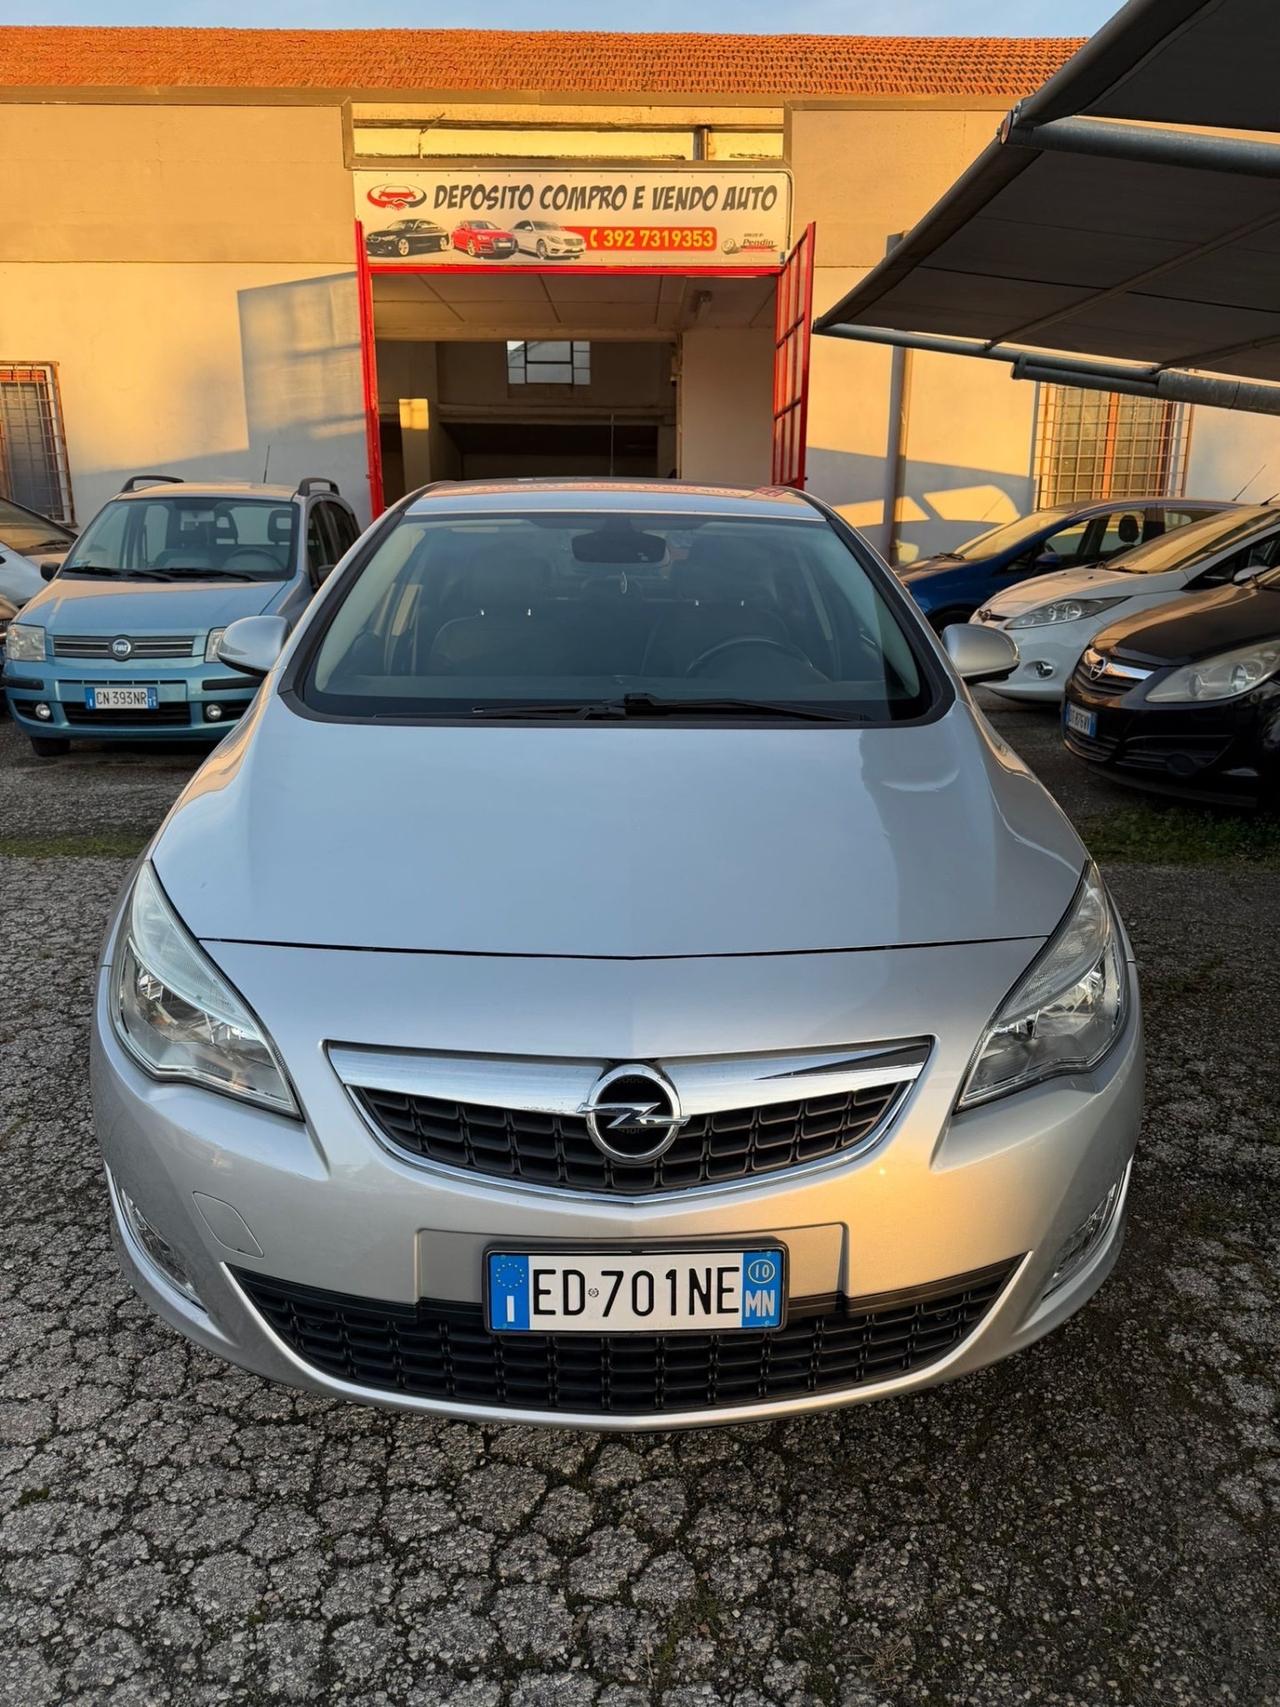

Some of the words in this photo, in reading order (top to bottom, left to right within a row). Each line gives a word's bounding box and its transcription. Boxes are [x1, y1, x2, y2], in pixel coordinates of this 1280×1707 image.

[434, 183, 534, 211] DEPOSITO
[540, 184, 627, 211] COMPRO
[632, 185, 646, 210] E
[652, 184, 718, 212] VENDO
[721, 184, 778, 212] AUTO
[603, 229, 635, 248] 392
[640, 229, 714, 248] 7319353
[96, 692, 110, 704] CN
[113, 691, 147, 705] 393NR
[533, 1269, 586, 1316] ED
[600, 1266, 740, 1318] 701NE
[745, 1289, 775, 1318] MN
[506, 1295, 515, 1322] I
